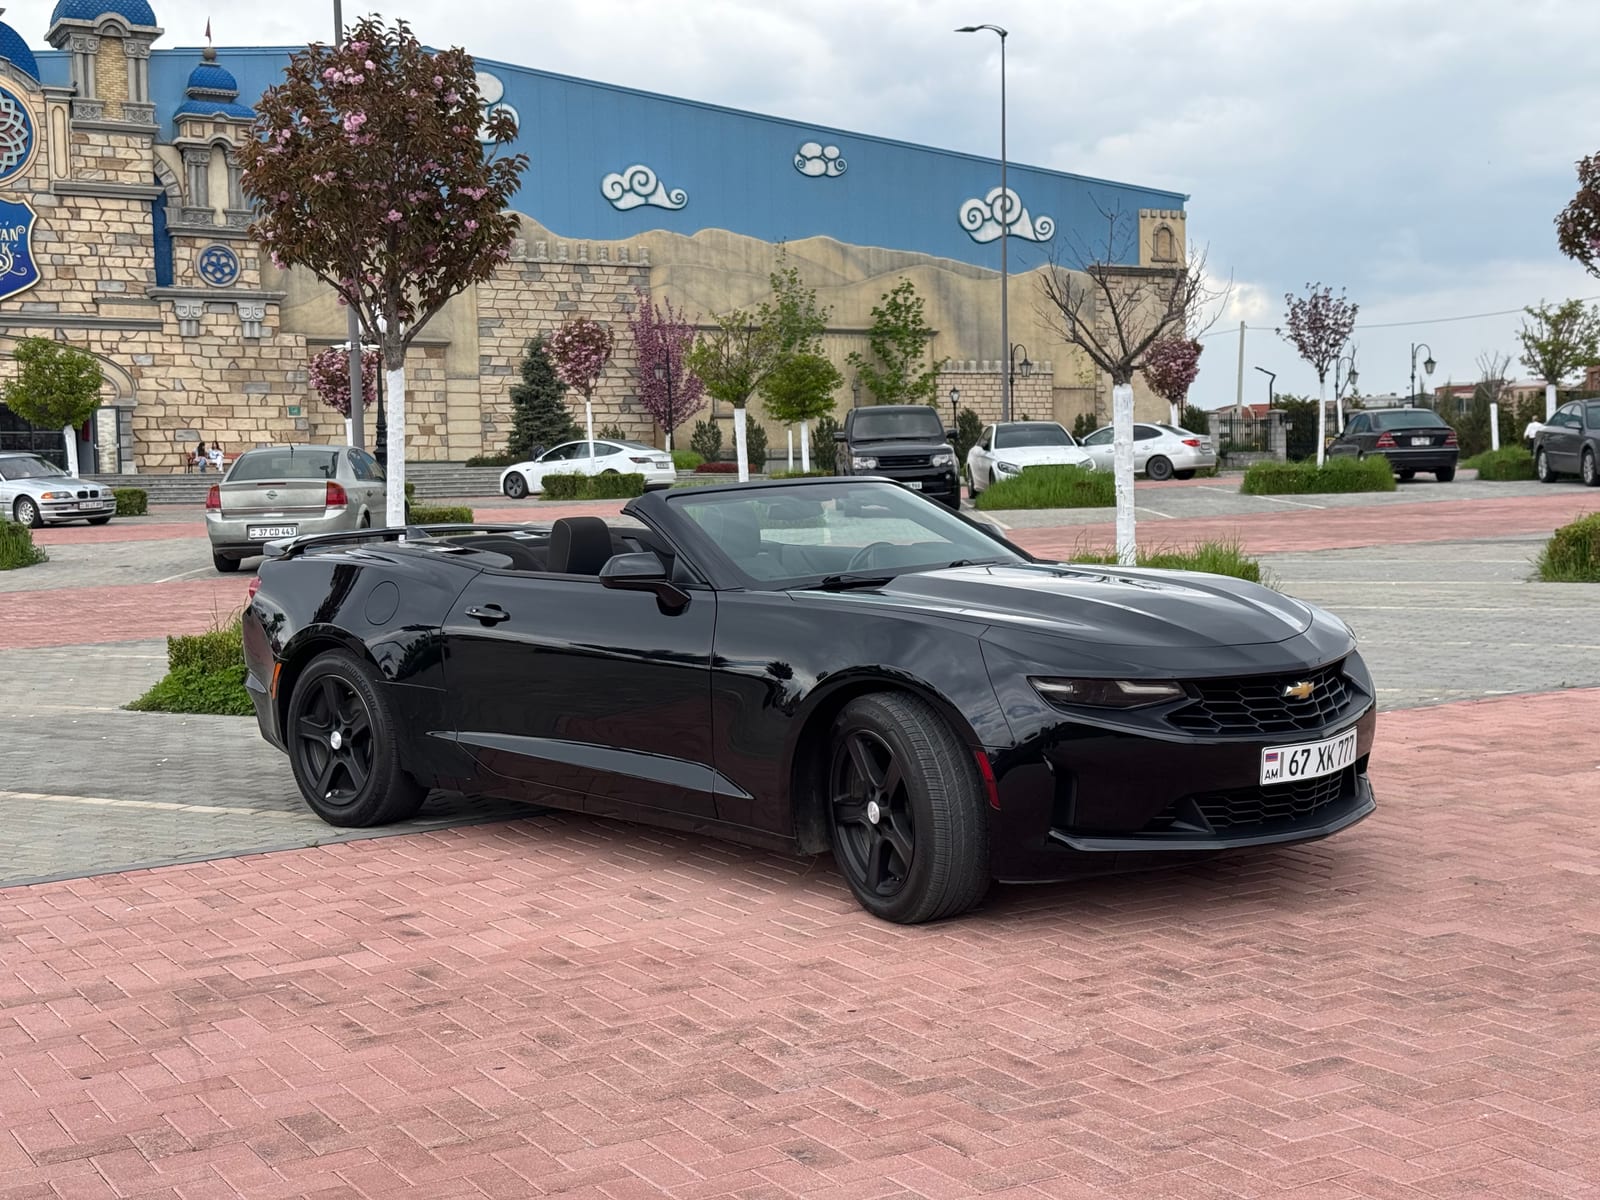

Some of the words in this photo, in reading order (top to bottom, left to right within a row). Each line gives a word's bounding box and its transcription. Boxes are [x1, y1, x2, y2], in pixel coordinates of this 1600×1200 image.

[0, 226, 22, 241] AN
[259, 528, 268, 537] 37
[269, 528, 280, 536] CD
[281, 527, 295, 536] 443
[1289, 748, 1311, 777] 67
[1315, 742, 1337, 773] XK
[1337, 734, 1355, 766] 777
[1264, 768, 1279, 781] AM
